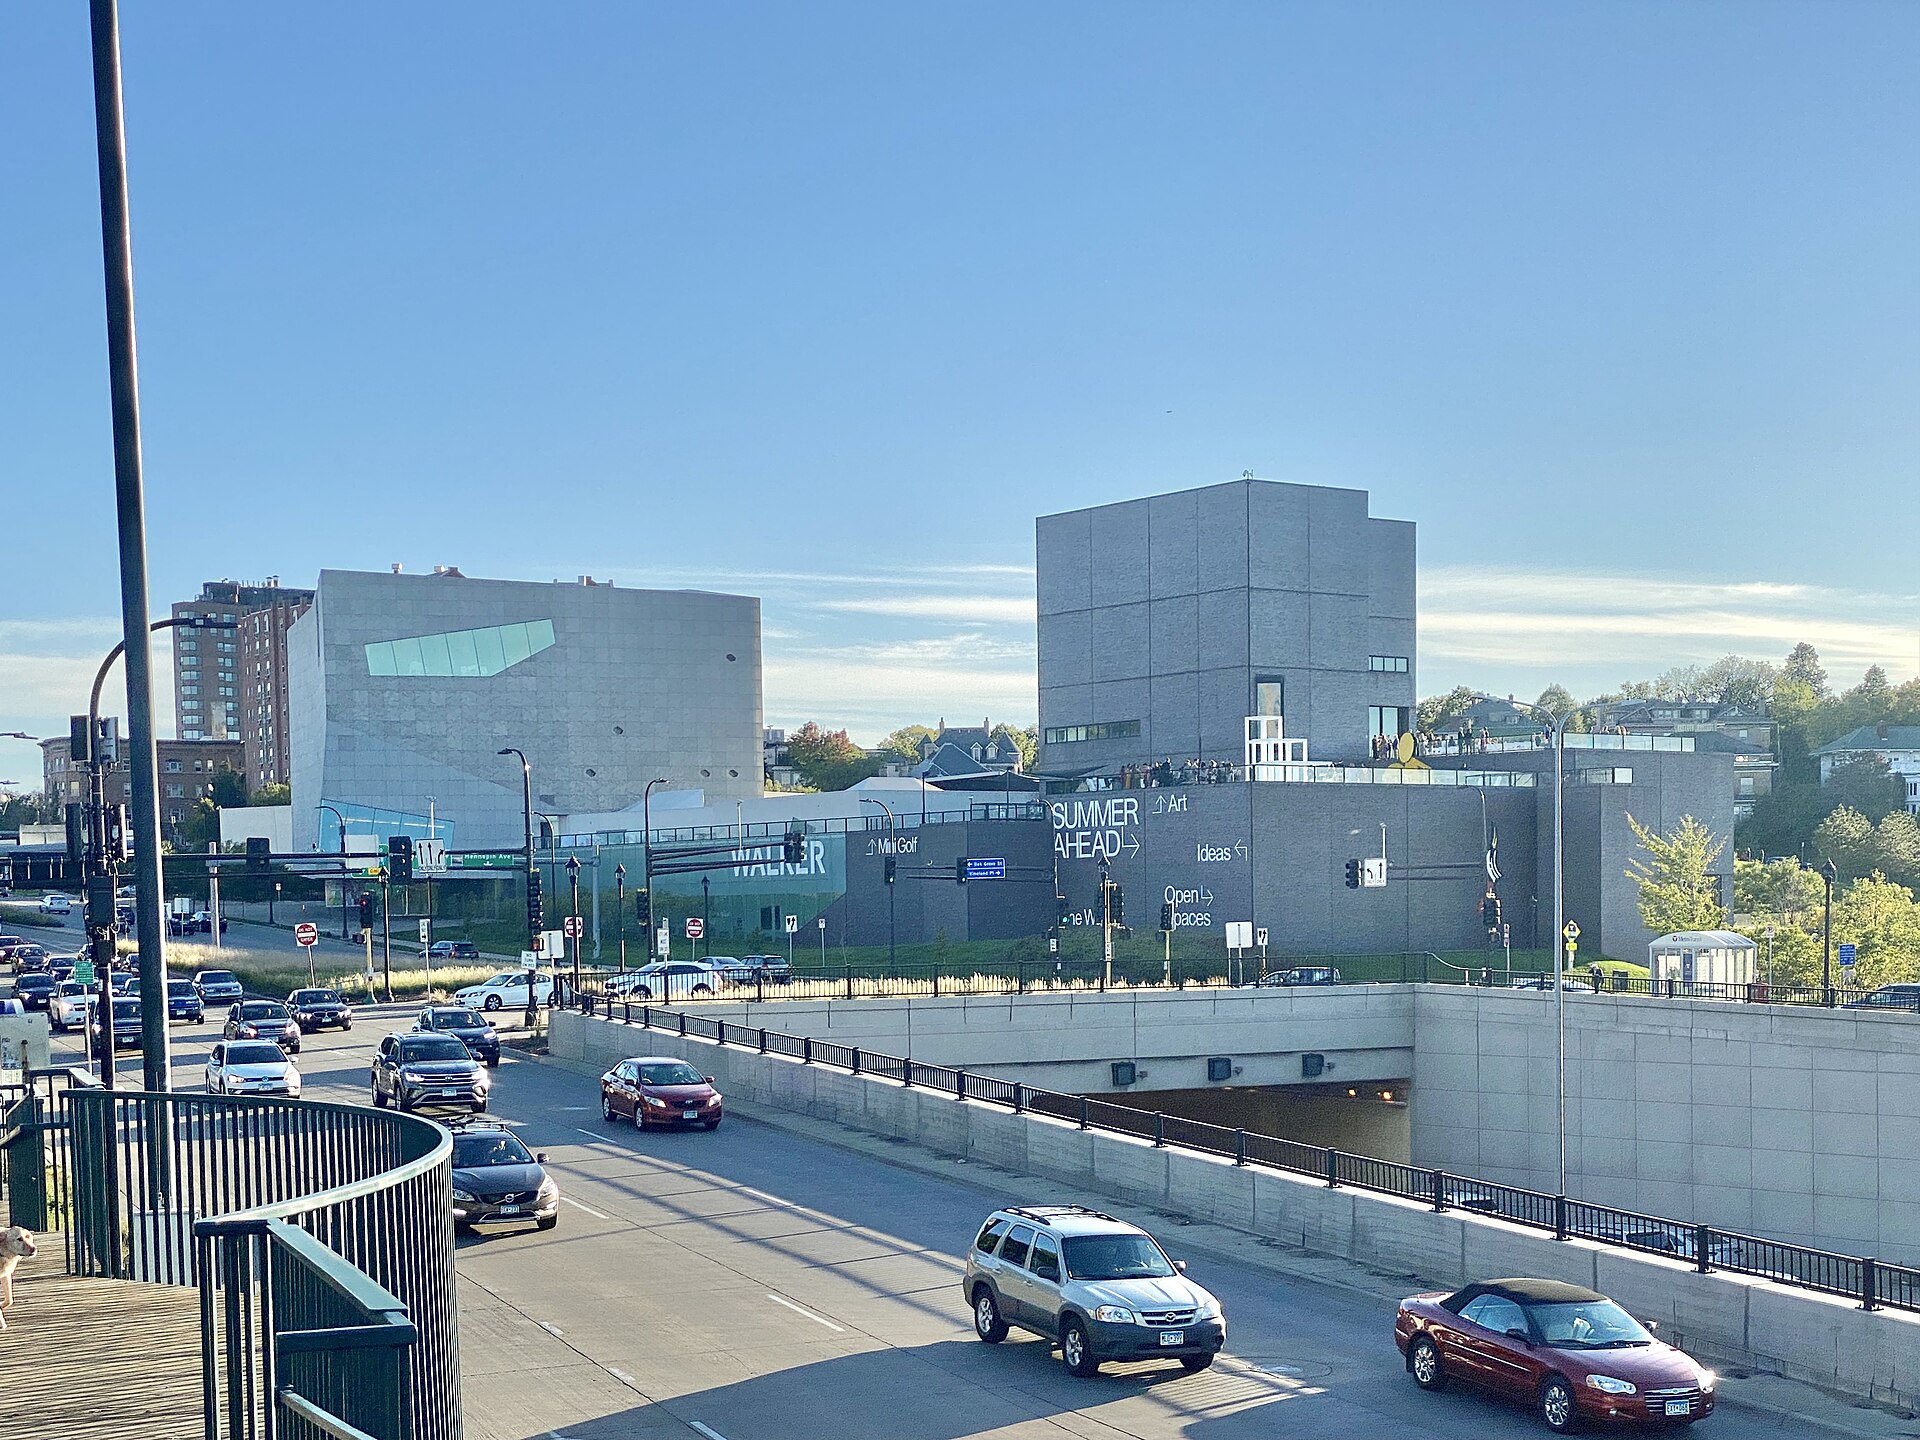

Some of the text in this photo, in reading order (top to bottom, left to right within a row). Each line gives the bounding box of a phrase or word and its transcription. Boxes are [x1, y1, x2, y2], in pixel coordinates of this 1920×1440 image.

[1168, 794, 1187, 812] Art
[1053, 797, 1139, 829] SUMMER
[897, 836, 918, 854] Golf
[1054, 829, 1121, 859] AHEAD
[1197, 844, 1231, 862] Ideas
[1164, 885, 1199, 908] Open
[1174, 912, 1212, 931] paces
